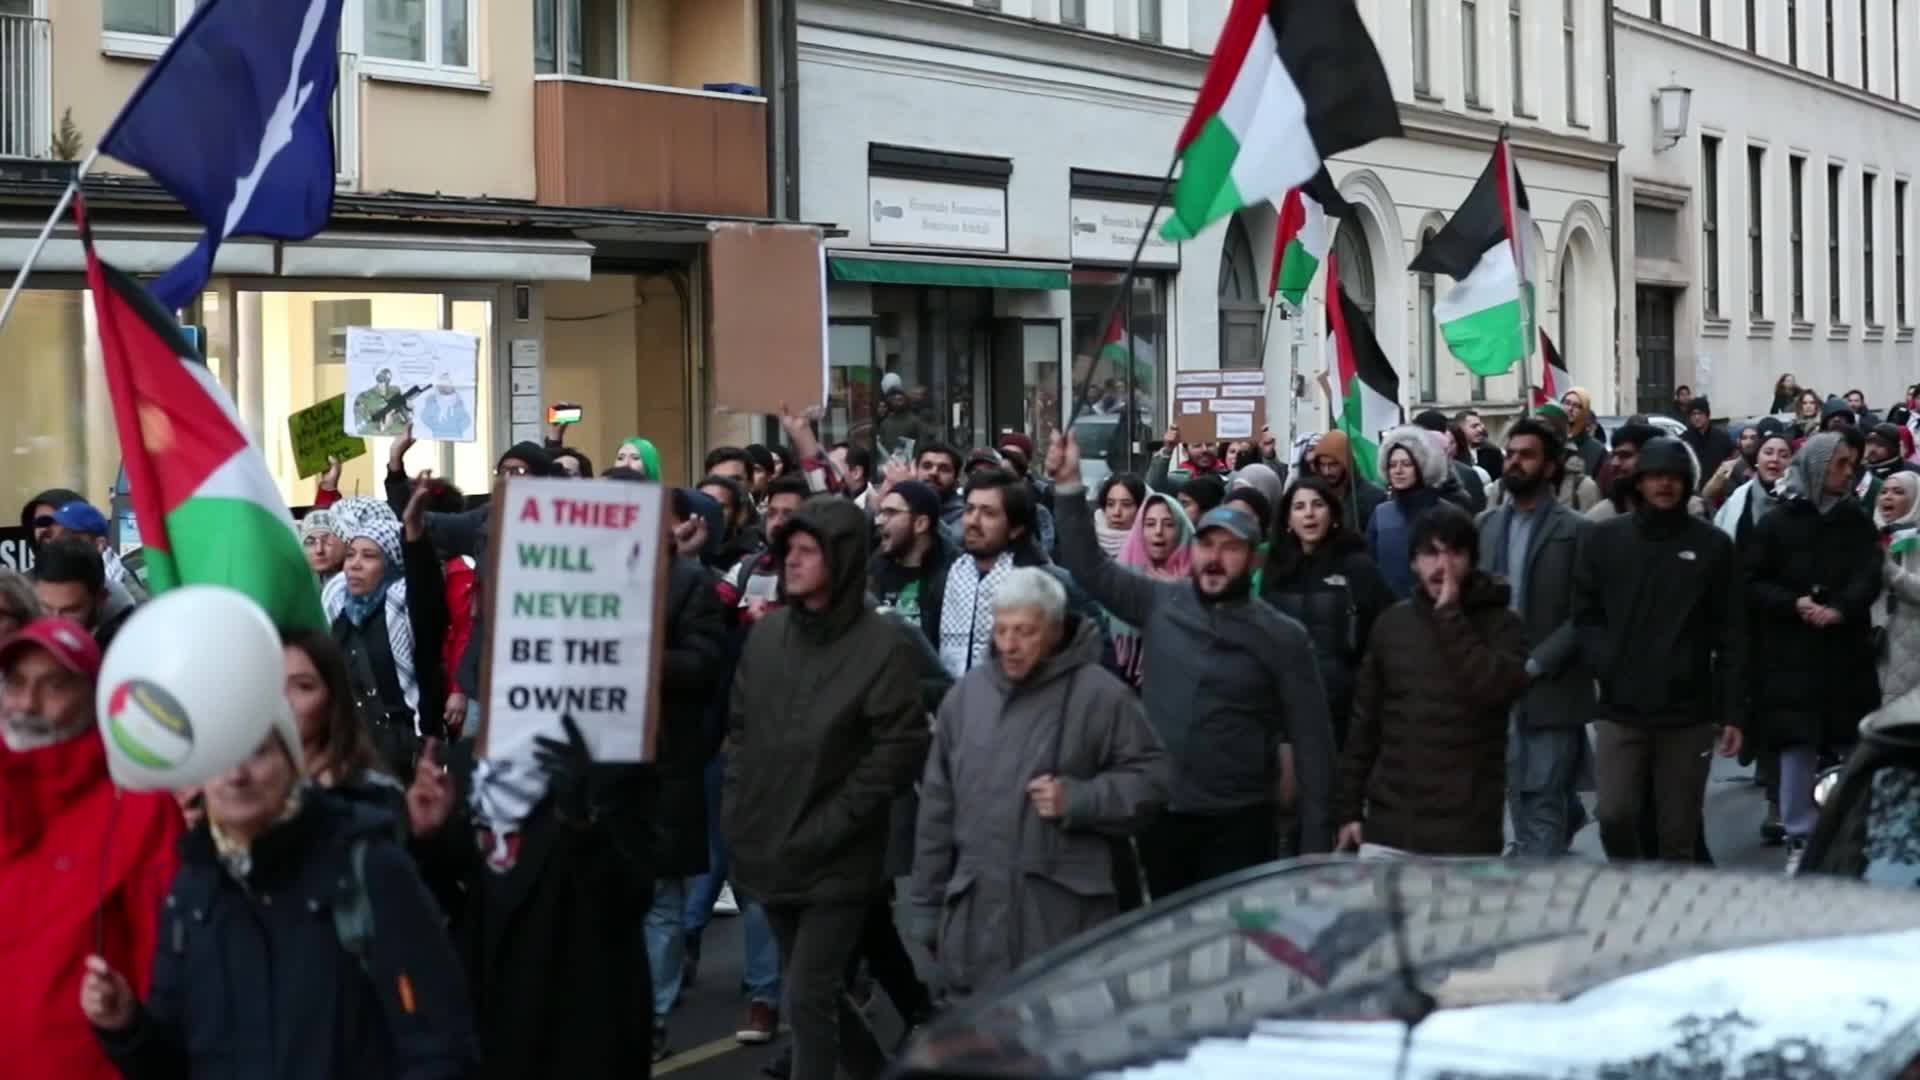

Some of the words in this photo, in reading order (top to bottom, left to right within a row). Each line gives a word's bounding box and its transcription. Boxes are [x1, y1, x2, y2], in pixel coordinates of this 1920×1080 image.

[519, 496, 541, 524] A
[551, 498, 640, 529] THIEF
[517, 543, 594, 572] WILL
[512, 592, 621, 619] NEVER
[511, 637, 552, 664] BE
[563, 639, 621, 665] THE
[508, 684, 628, 713] OWNER
